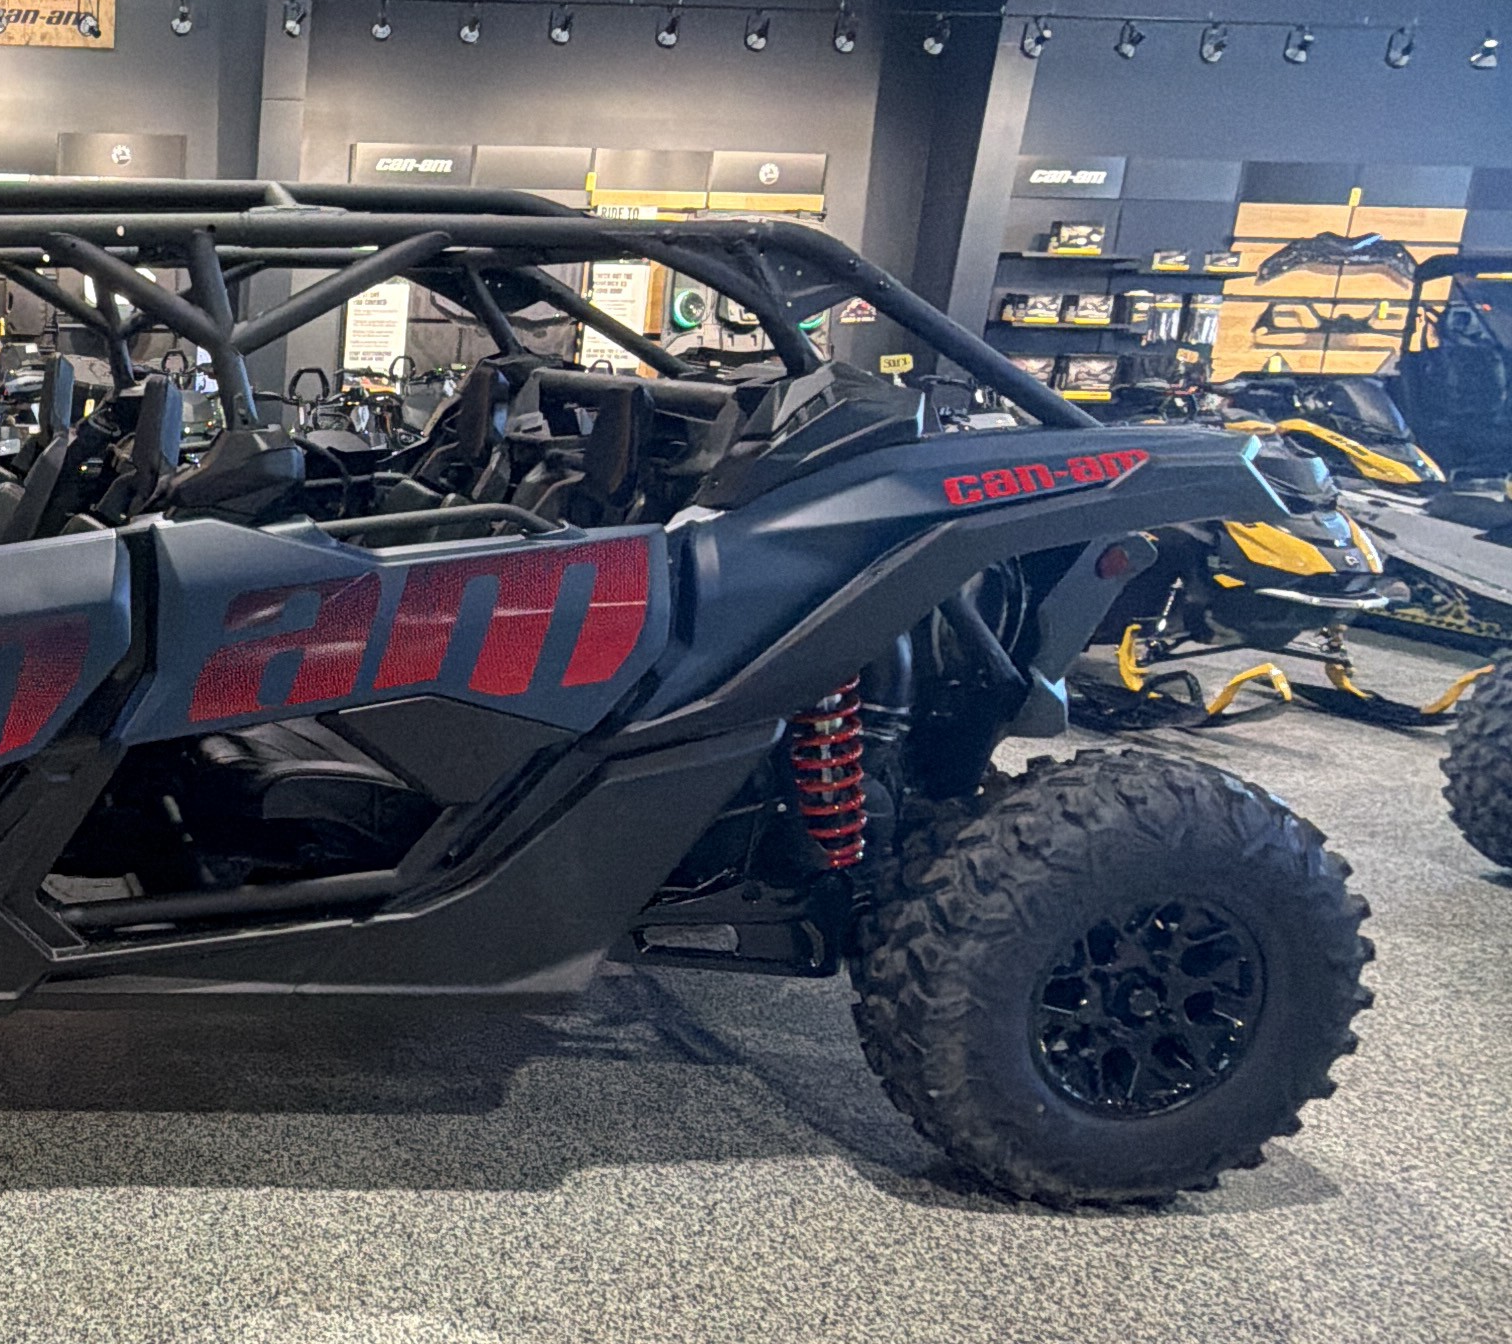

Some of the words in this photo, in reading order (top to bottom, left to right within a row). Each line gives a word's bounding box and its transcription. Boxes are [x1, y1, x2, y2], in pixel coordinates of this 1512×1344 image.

[375, 158, 453, 173] can-am
[1029, 169, 1107, 184] can-am
[943, 449, 1150, 506] can-am
